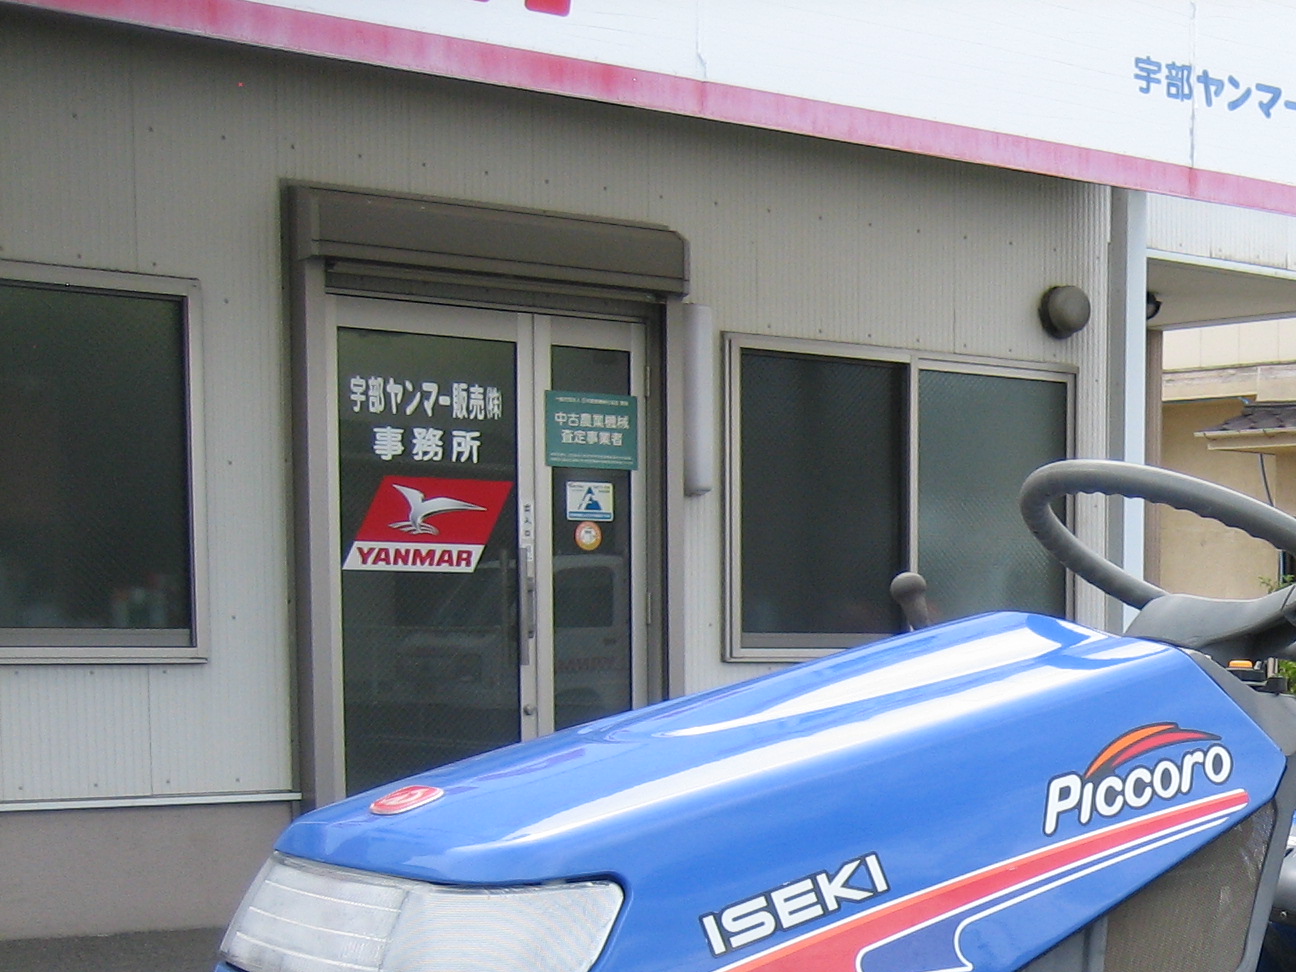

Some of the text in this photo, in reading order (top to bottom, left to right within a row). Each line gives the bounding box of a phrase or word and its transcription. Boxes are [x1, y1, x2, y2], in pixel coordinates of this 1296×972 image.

[554, 411, 630, 430] 中古農業機械
[372, 425, 482, 464] 事務所
[560, 429, 624, 447] 査定事業者
[356, 546, 473, 568] YANMAR
[1043, 743, 1233, 836] Piccoro
[701, 852, 889, 956] ISEKI
